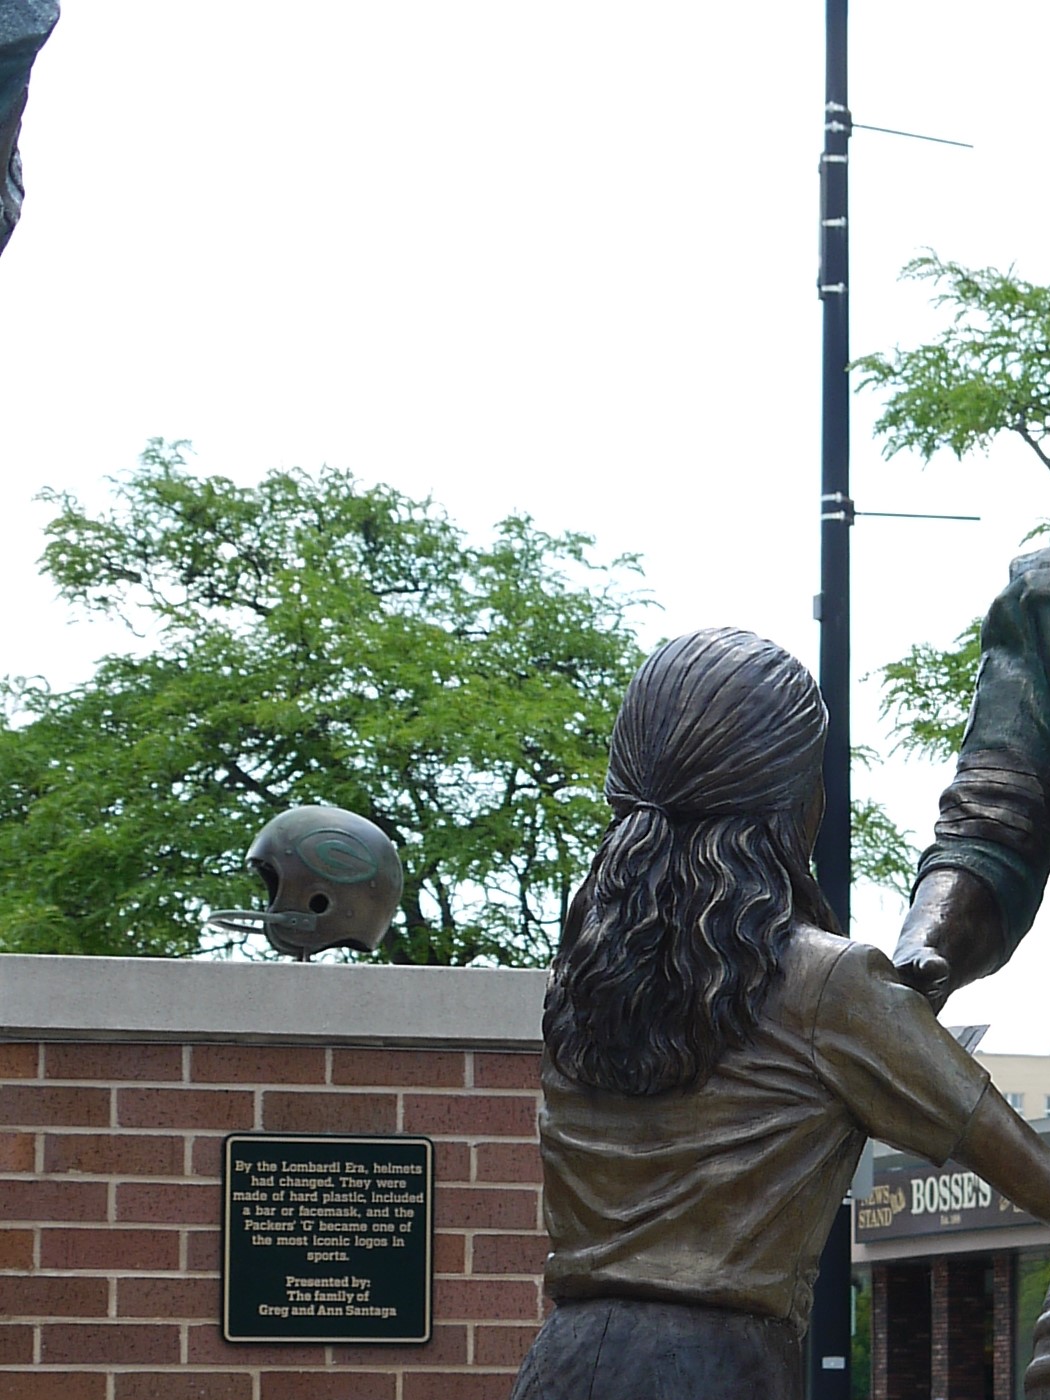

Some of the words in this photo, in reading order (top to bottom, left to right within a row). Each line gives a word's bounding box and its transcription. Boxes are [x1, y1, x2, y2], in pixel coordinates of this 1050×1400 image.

[235, 1161, 252, 1173] By
[257, 1161, 277, 1172] the
[282, 1161, 340, 1172] Lombardi
[345, 1163, 368, 1174] Era,
[373, 1163, 422, 1174] helmets
[251, 1176, 274, 1186] had
[279, 1176, 334, 1189] changed.
[340, 1177, 371, 1189] They
[376, 1179, 407, 1188] were
[233, 1191, 267, 1201] made
[272, 1191, 284, 1201] of
[289, 1191, 317, 1202] hard
[323, 1192, 367, 1204] plastic,
[372, 1192, 423, 1203] included
[242, 1207, 250, 1216] a
[255, 1206, 276, 1216] bar
[281, 1207, 293, 1216] or
[299, 1206, 361, 1218] facemask,
[366, 1207, 389, 1217] and
[394, 1207, 414, 1217] the
[858, 1207, 892, 1229] STAND
[319, 1221, 367, 1231] became
[372, 1223, 395, 1232] one
[400, 1221, 412, 1232] of
[252, 1235, 272, 1245] the
[276, 1236, 308, 1245] most
[313, 1235, 350, 1246] iconic
[355, 1236, 387, 1247] logos
[392, 1237, 404, 1247] in
[307, 1251, 350, 1263] sports.
[286, 1277, 349, 1287] Presented
[352, 1277, 370, 1289] by:
[287, 1291, 311, 1301] The
[314, 1291, 353, 1303] family
[357, 1291, 369, 1301] of
[259, 1305, 289, 1317] Greg
[291, 1305, 314, 1316] and
[317, 1305, 343, 1316] Ann
[346, 1306, 397, 1318] Santaga
